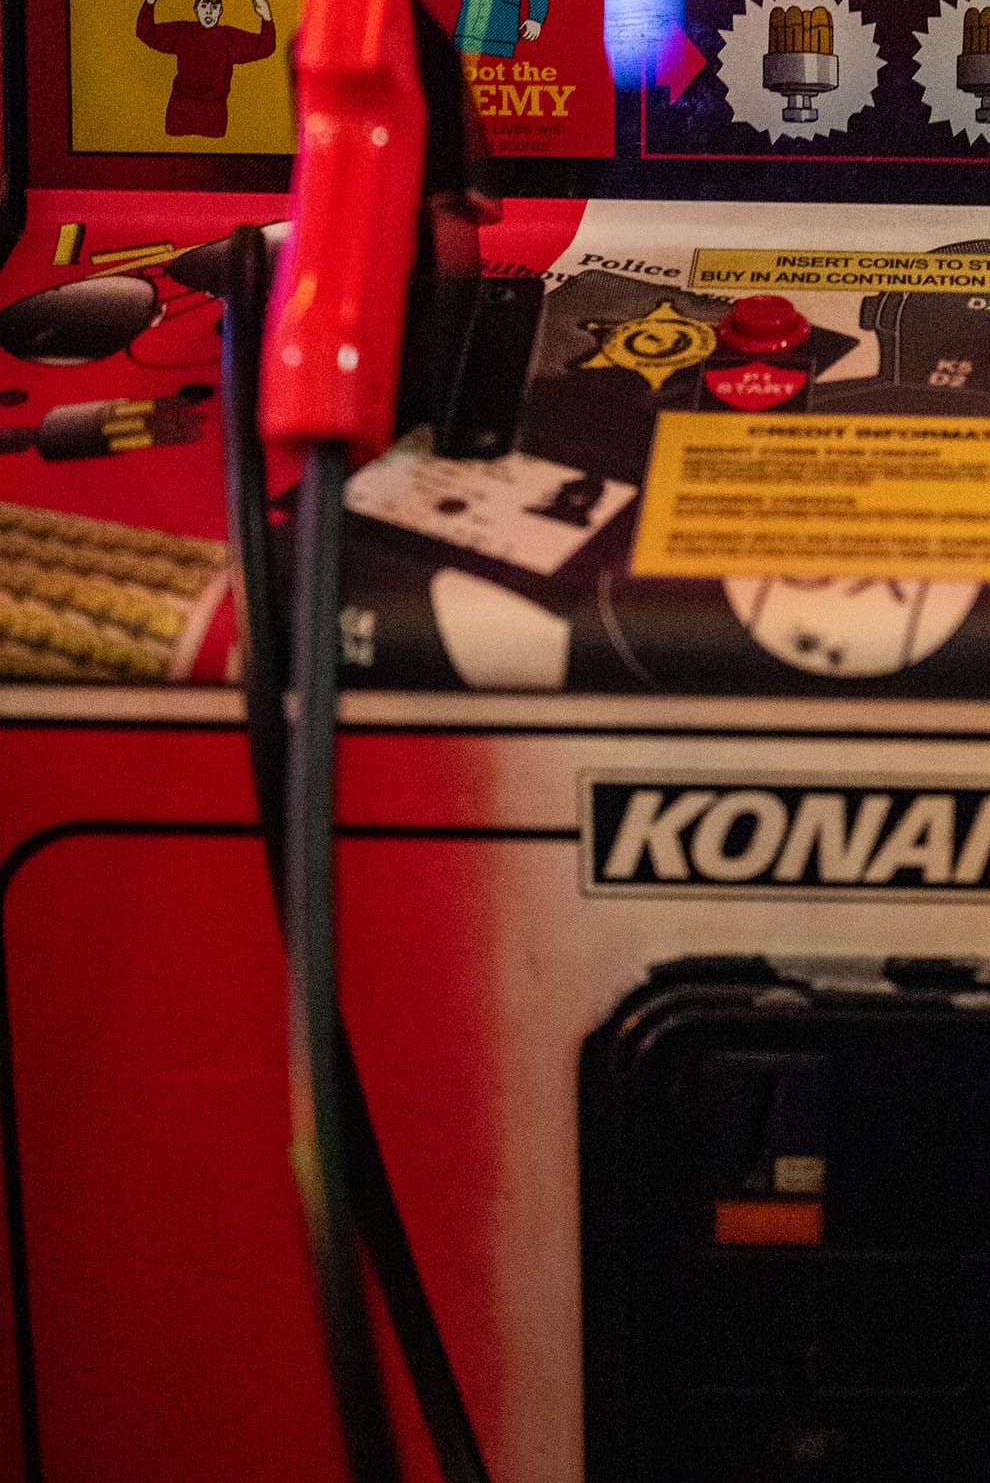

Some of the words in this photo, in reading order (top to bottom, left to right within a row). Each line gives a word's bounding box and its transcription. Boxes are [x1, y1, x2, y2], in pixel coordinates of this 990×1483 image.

[512, 62, 557, 82] the
[578, 253, 681, 278] Police
[776, 256, 852, 267] INSERT
[858, 257, 929, 270] COIN/S
[935, 259, 963, 269] TO
[701, 270, 745, 282] BUY
[750, 271, 770, 282] IN
[775, 272, 821, 284] AND
[826, 273, 985, 286] CONTINUATION
